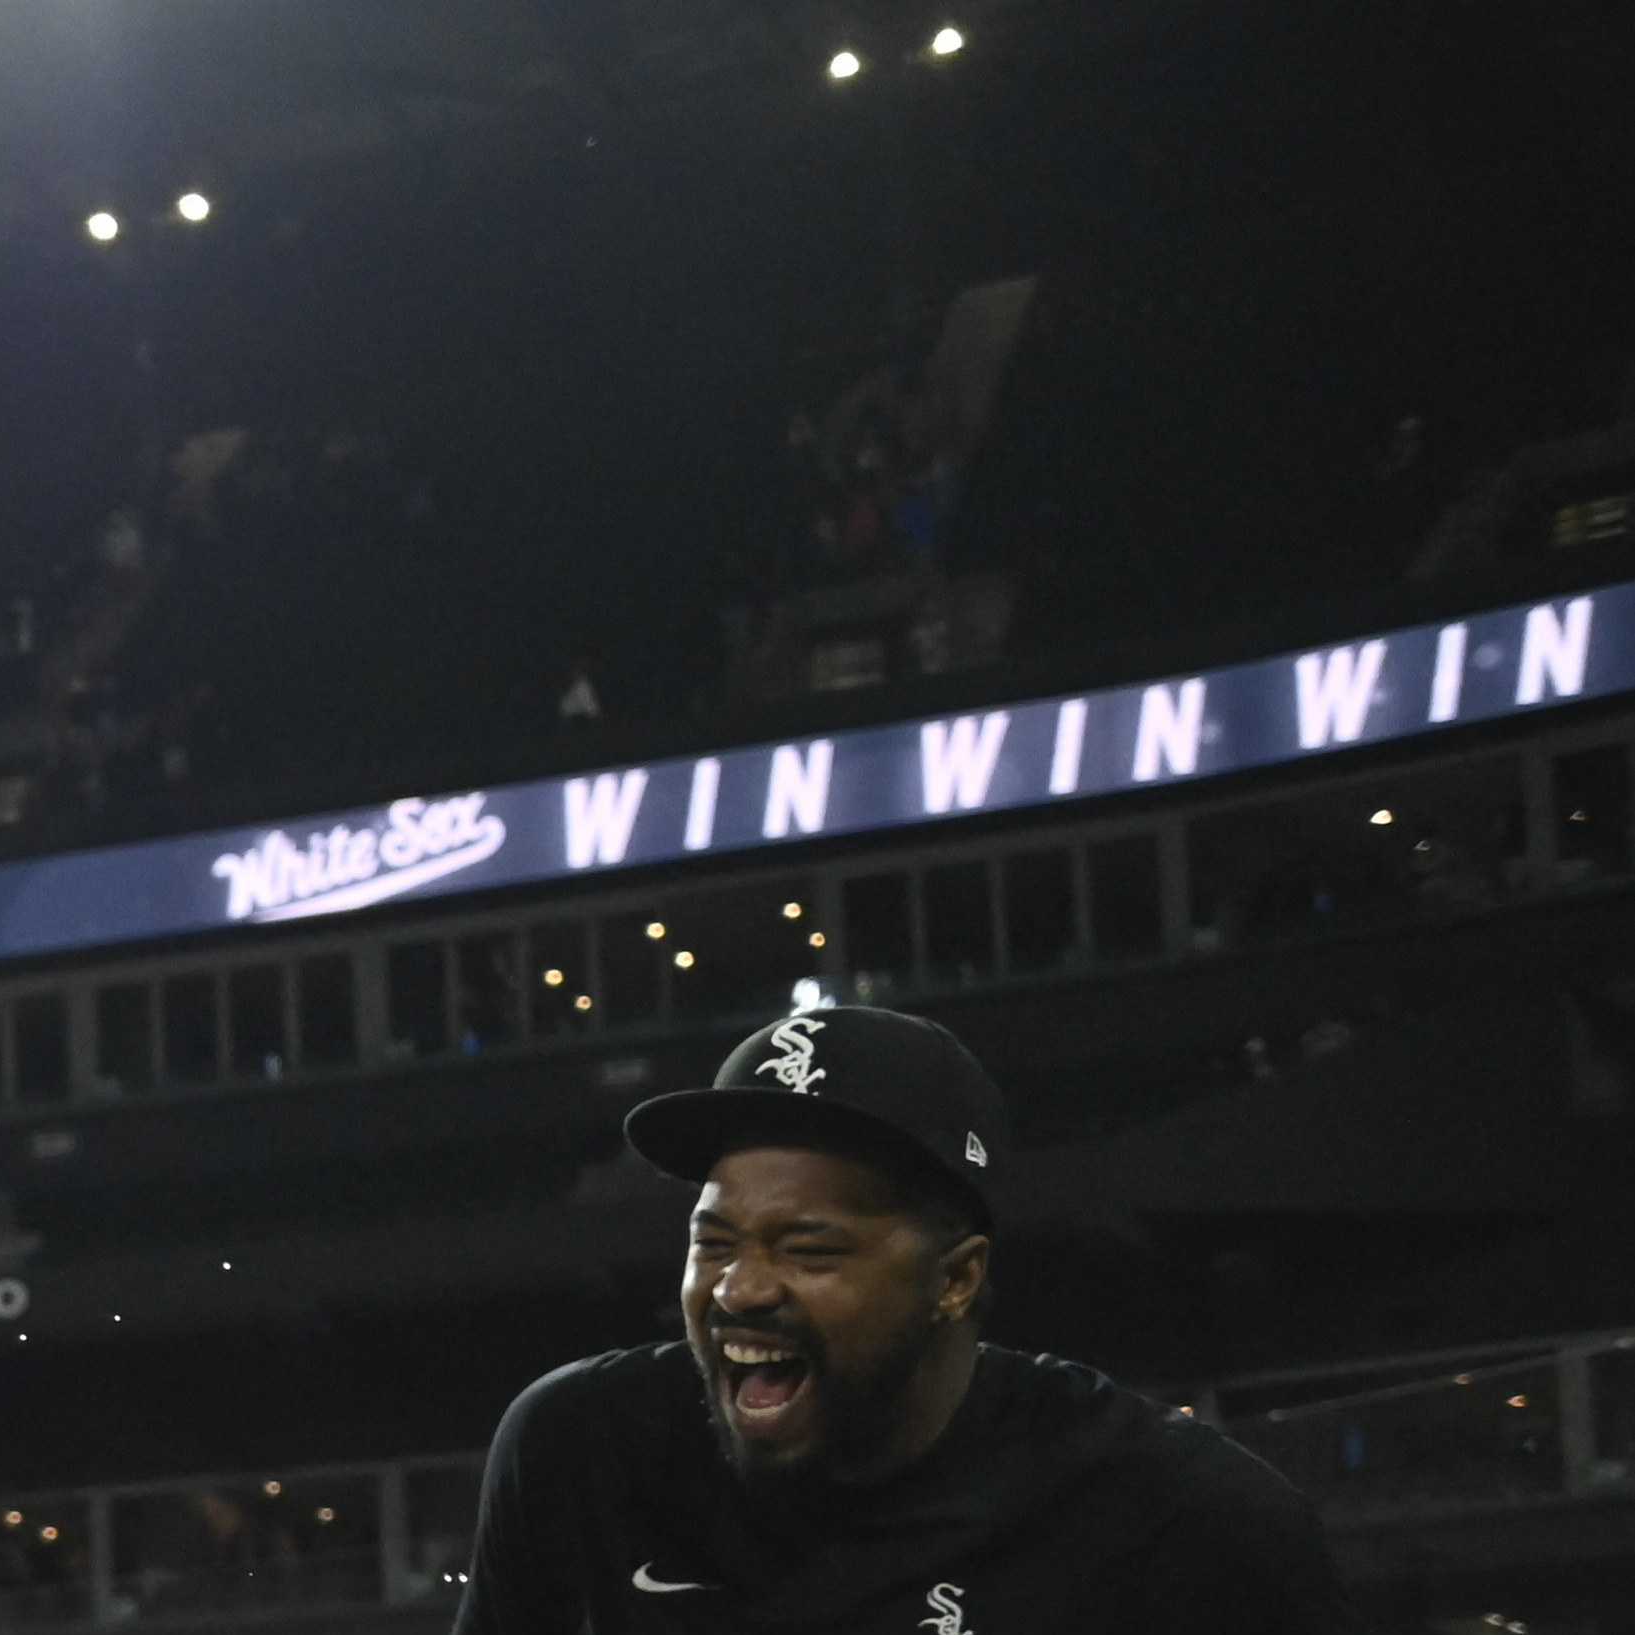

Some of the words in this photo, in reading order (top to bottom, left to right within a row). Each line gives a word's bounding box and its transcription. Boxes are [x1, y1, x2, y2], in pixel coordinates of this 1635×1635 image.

[212, 828, 377, 921] White
[379, 796, 502, 870] Sox
[564, 741, 832, 868] WIN
[920, 677, 1205, 814] WIN
[1293, 597, 1595, 749] WIN
